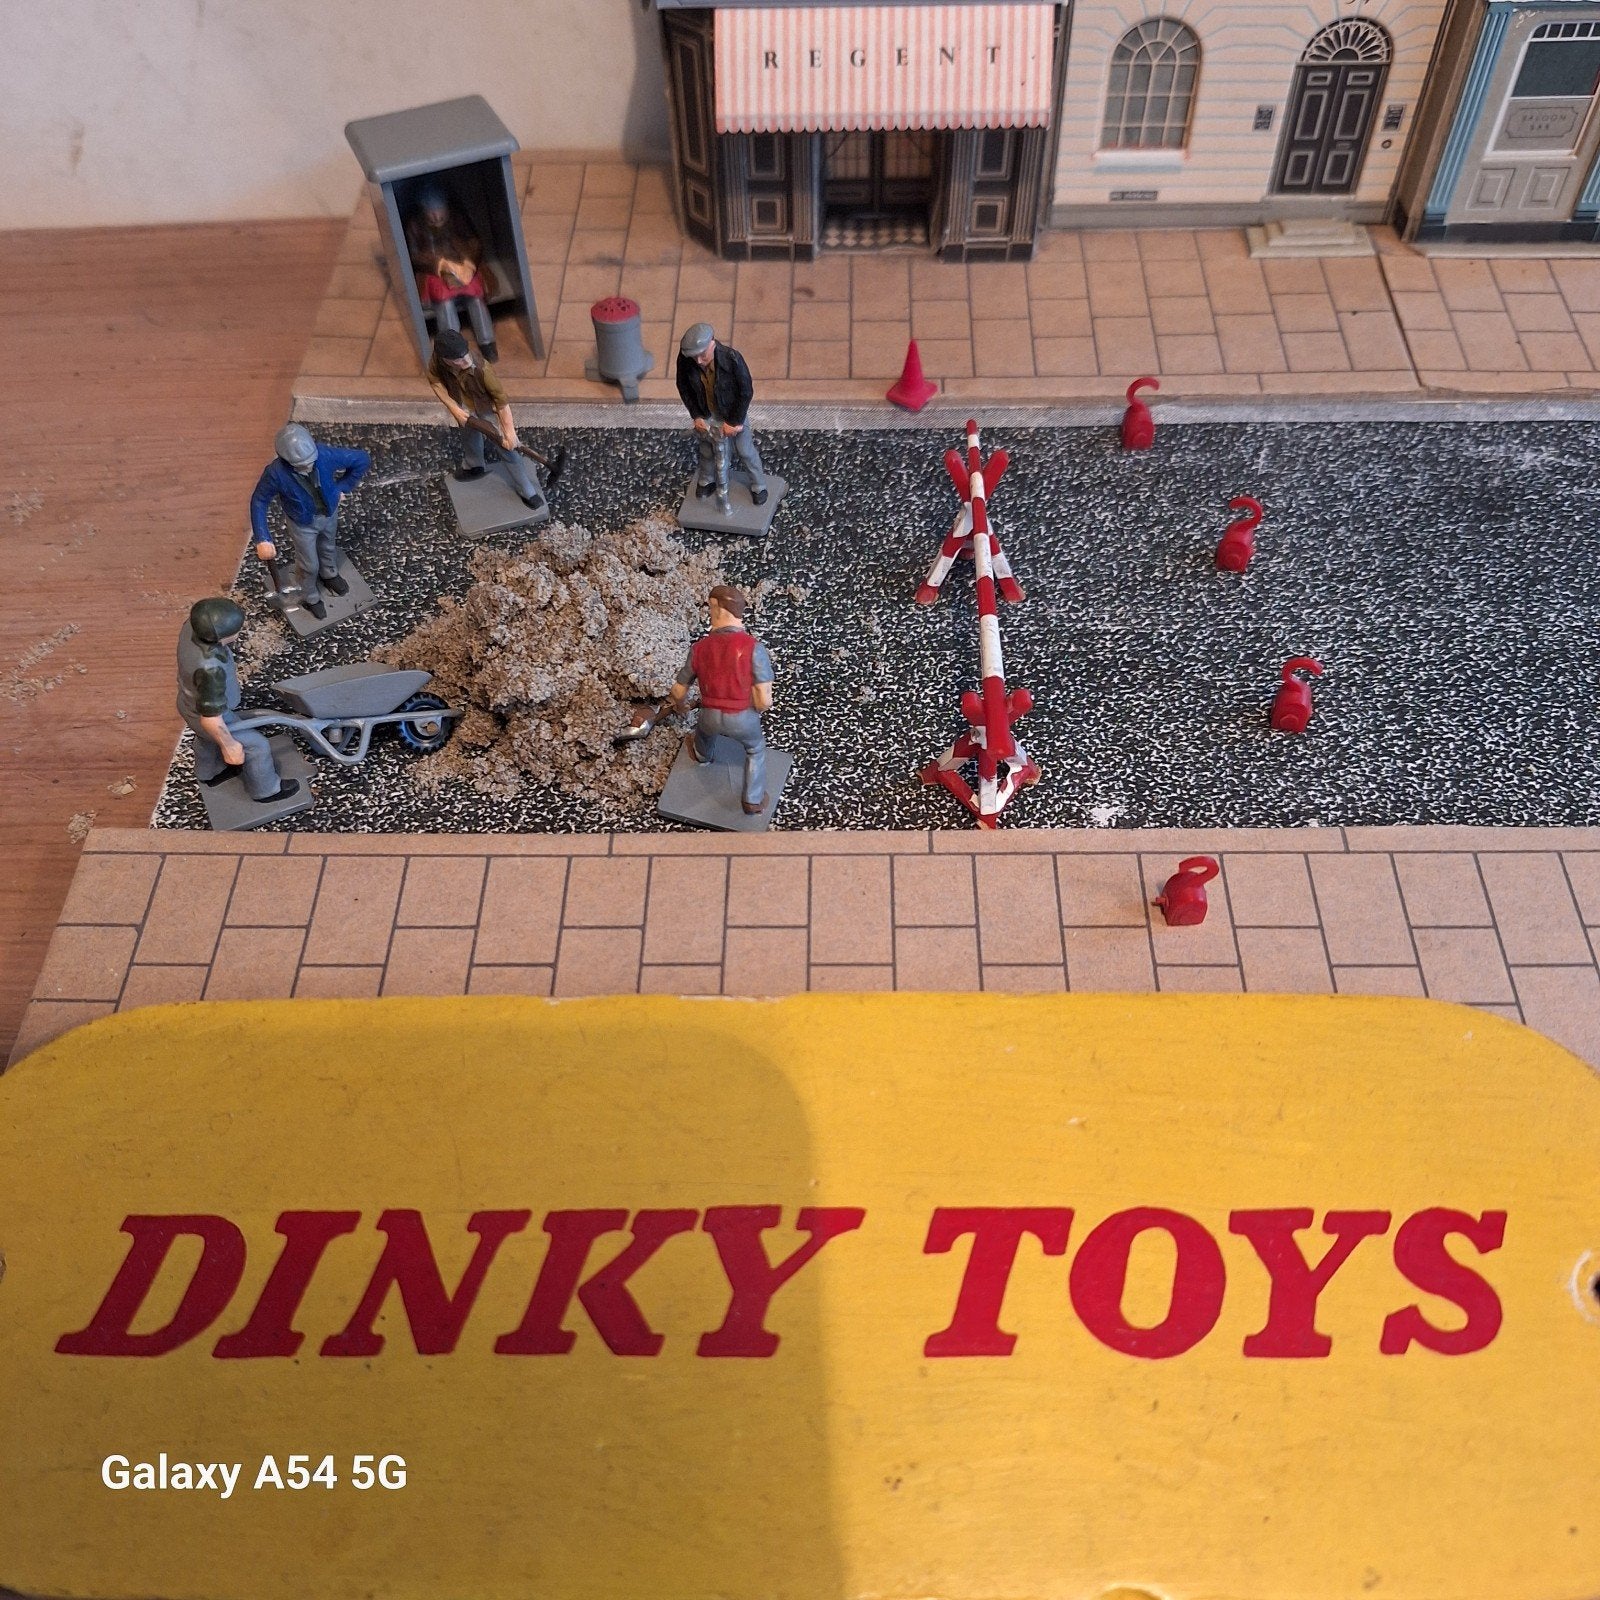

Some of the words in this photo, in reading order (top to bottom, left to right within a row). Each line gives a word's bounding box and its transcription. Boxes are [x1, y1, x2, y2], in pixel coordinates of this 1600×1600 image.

[764, 47, 1001, 69] REGENT
[56, 1203, 866, 1359] DINKY
[922, 1206, 1508, 1359] TOYS
